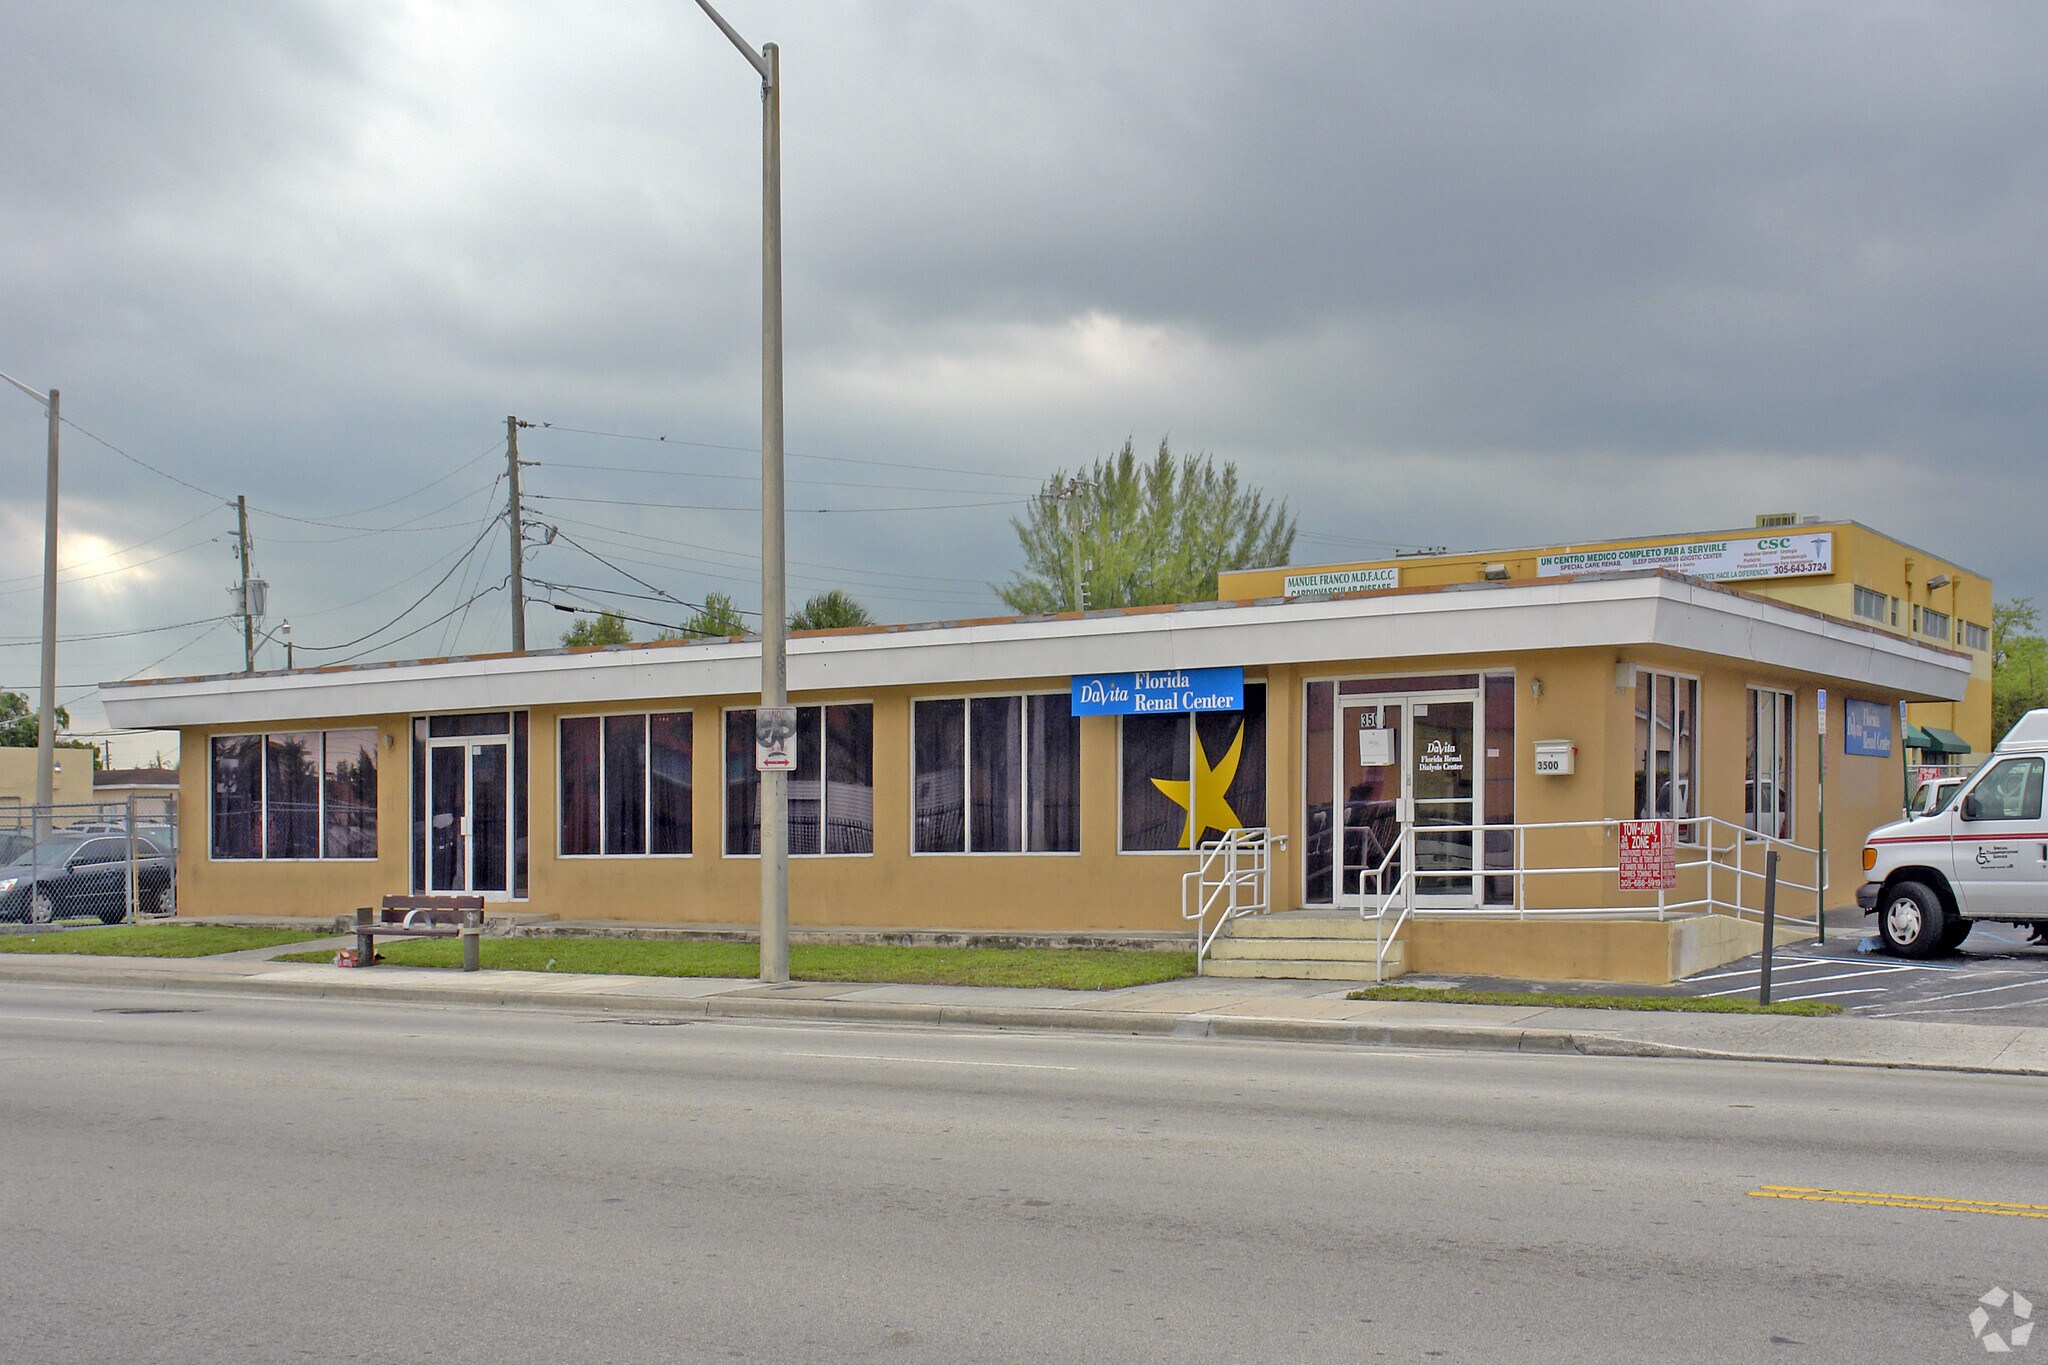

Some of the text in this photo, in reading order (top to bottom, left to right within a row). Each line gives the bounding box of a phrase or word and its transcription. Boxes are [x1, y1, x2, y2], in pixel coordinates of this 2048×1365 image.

[1541, 543, 1727, 566] UN CENTRO MEDICO COMPLETO PARA SERVIRLE
[1648, 556, 1672, 564] DISORDER
[1774, 562, 1827, 575] 305-643-3724
[1288, 576, 1318, 588] MANUEL
[1320, 573, 1350, 585] FRANCO
[1135, 671, 1190, 690] Florida
[1081, 680, 1128, 706] DaVita
[1135, 691, 1234, 712] Renal Center
[1428, 740, 1456, 754] DaVita
[1421, 754, 1442, 762] Florida
[1420, 764, 1442, 772] Dialysis
[1538, 761, 1558, 770] 3500
[1623, 822, 1657, 836] TOW-AWAY
[1631, 835, 1650, 848] ZONE
